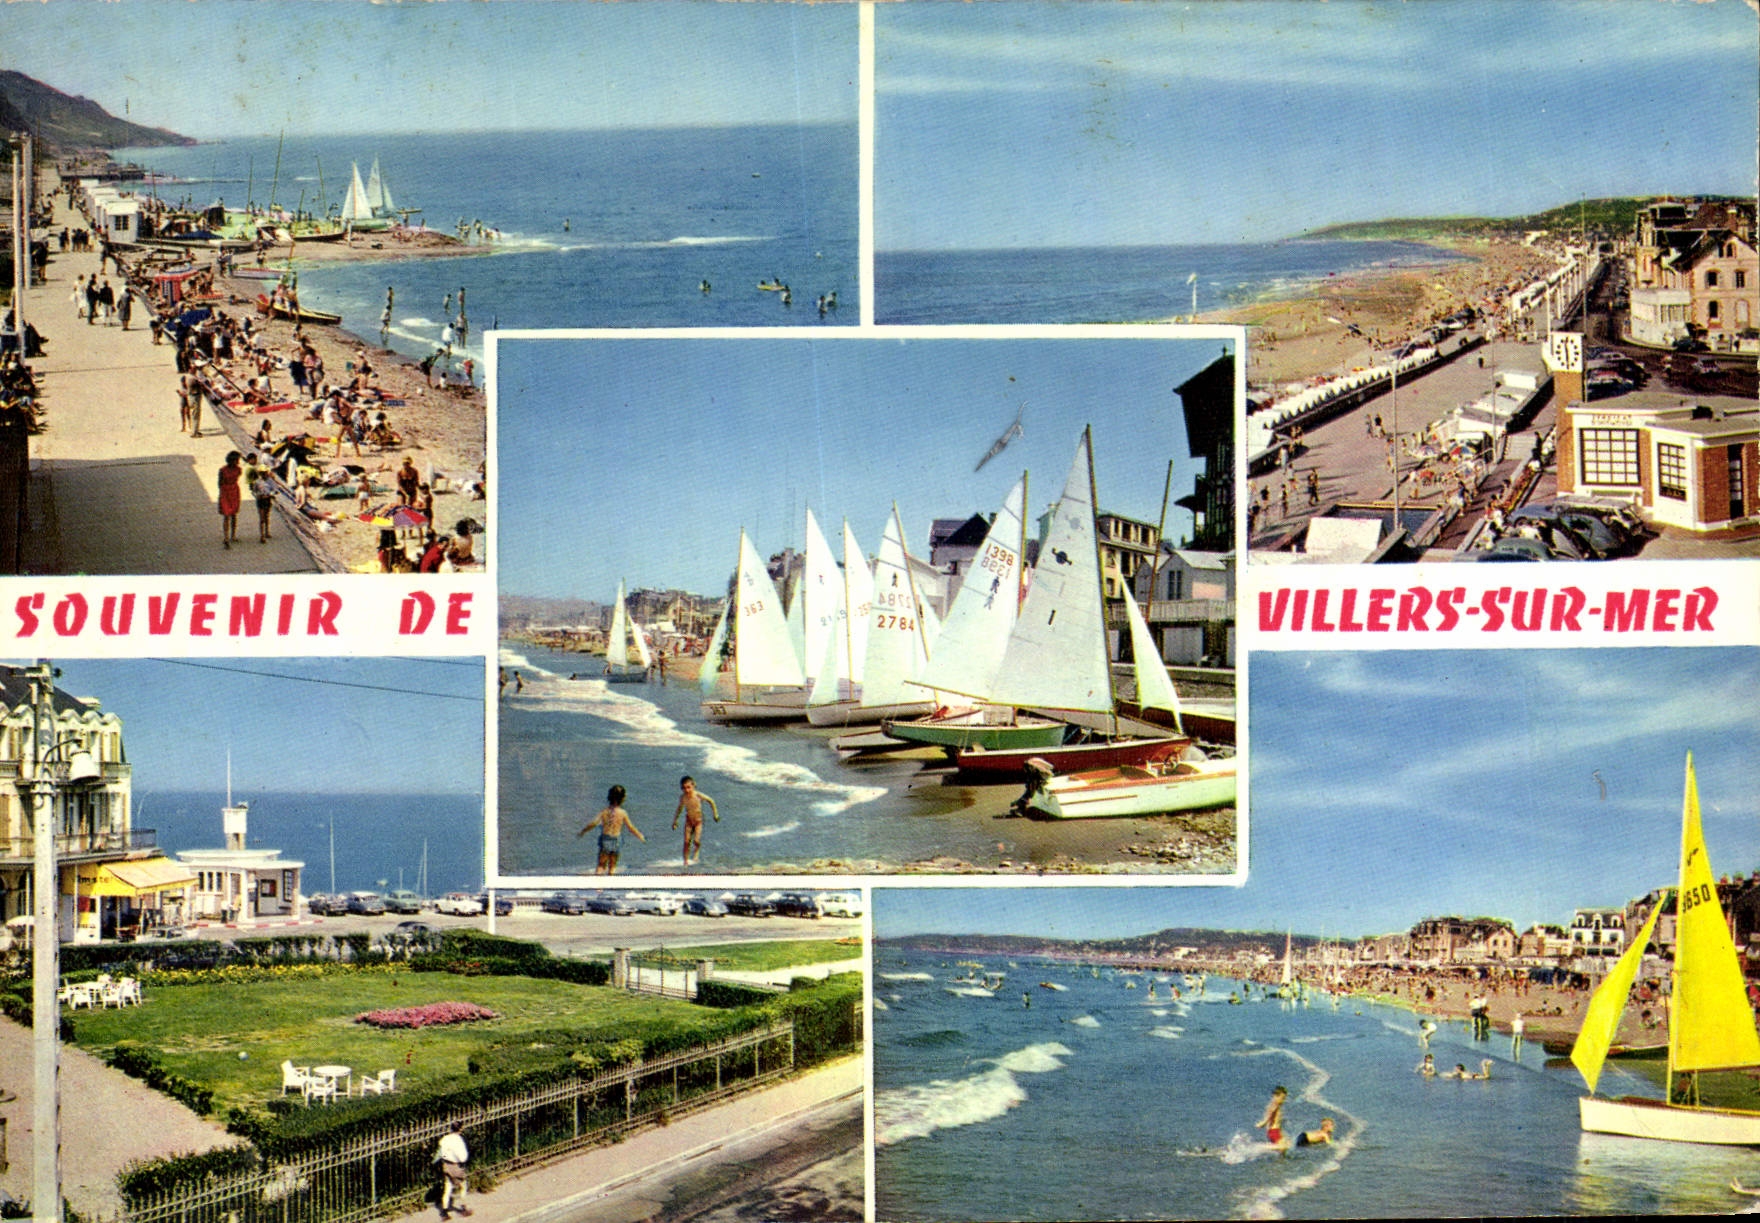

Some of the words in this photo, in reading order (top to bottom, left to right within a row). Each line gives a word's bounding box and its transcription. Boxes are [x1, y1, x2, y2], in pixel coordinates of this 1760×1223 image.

[985, 543, 1014, 566] 1398
[743, 600, 764, 617] 363
[877, 614, 914, 631] 2784
